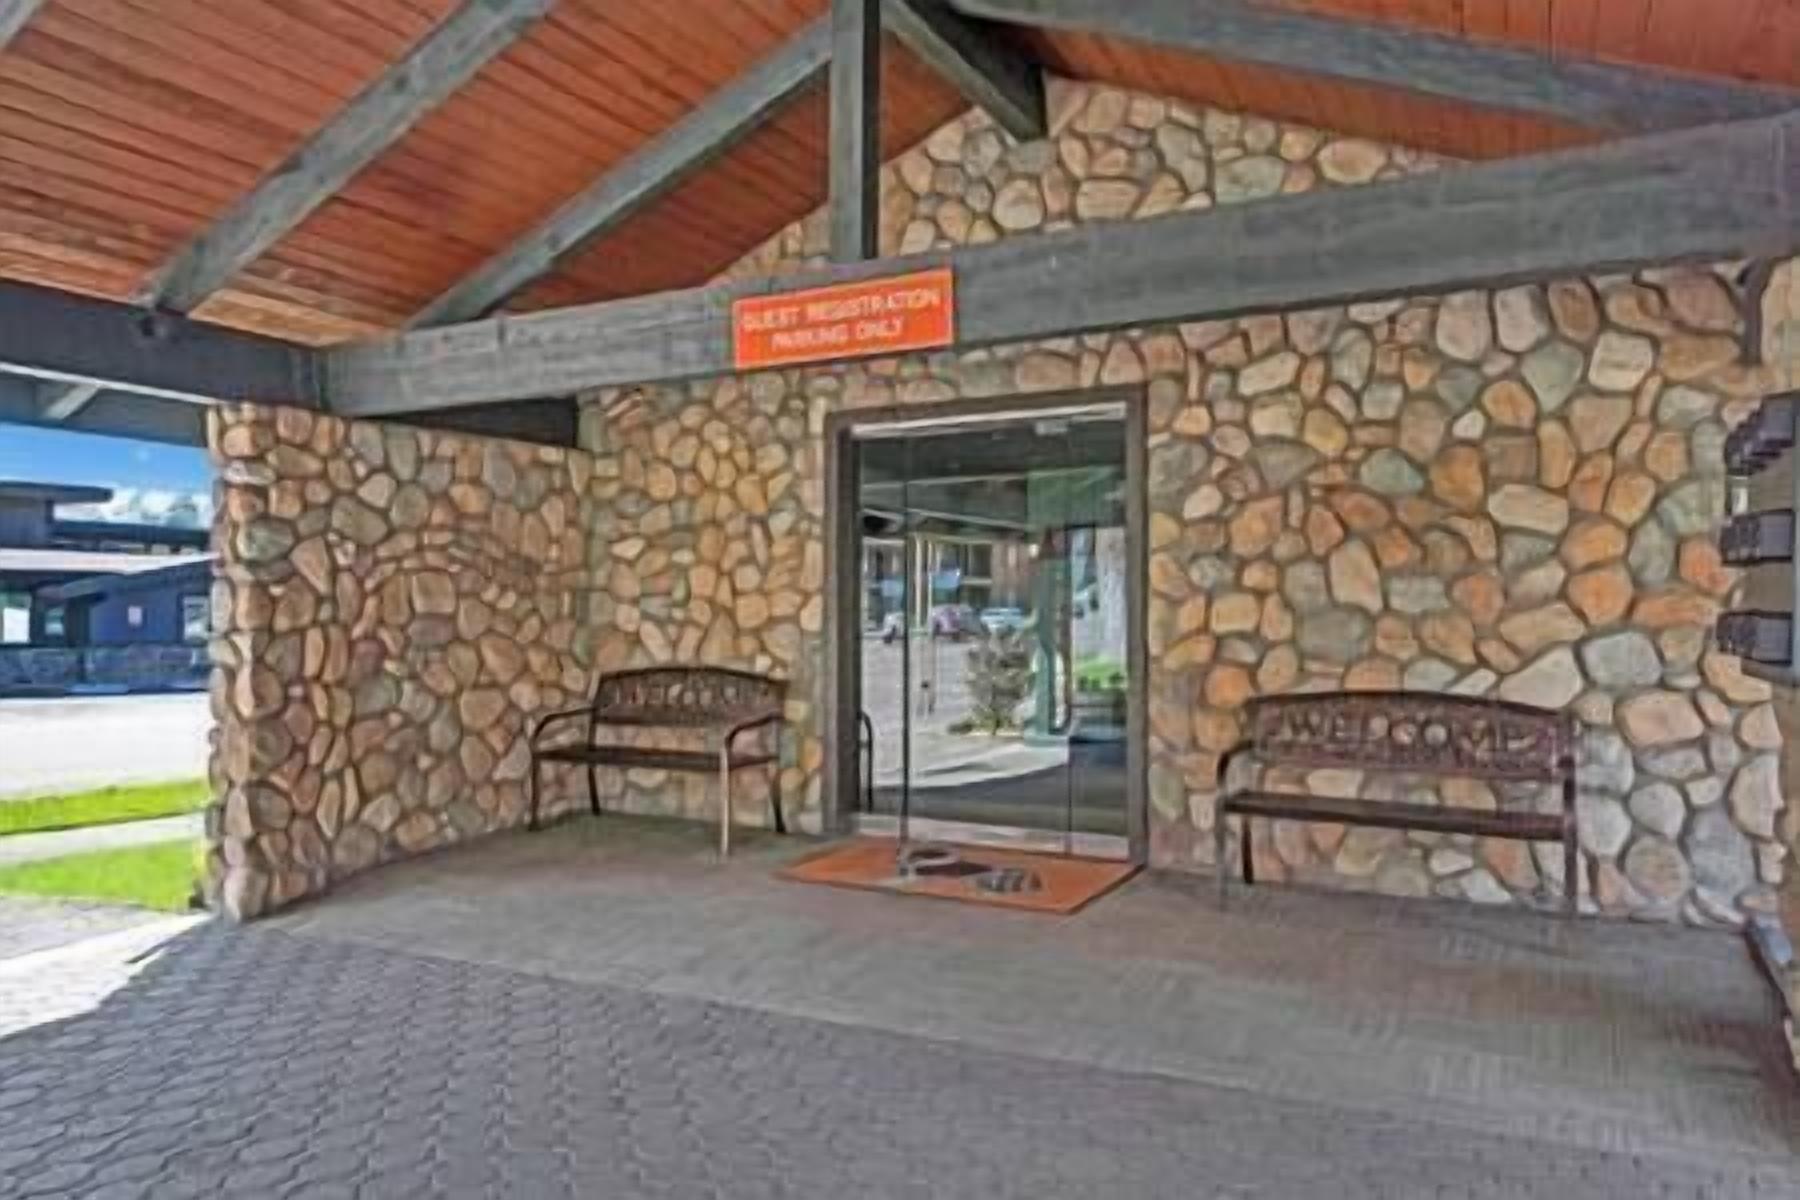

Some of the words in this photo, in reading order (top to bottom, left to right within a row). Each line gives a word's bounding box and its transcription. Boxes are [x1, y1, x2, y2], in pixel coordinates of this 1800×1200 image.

[806, 288, 941, 322] REGISTRATION
[771, 324, 849, 352] PARKING
[855, 316, 904, 341] ONLY
